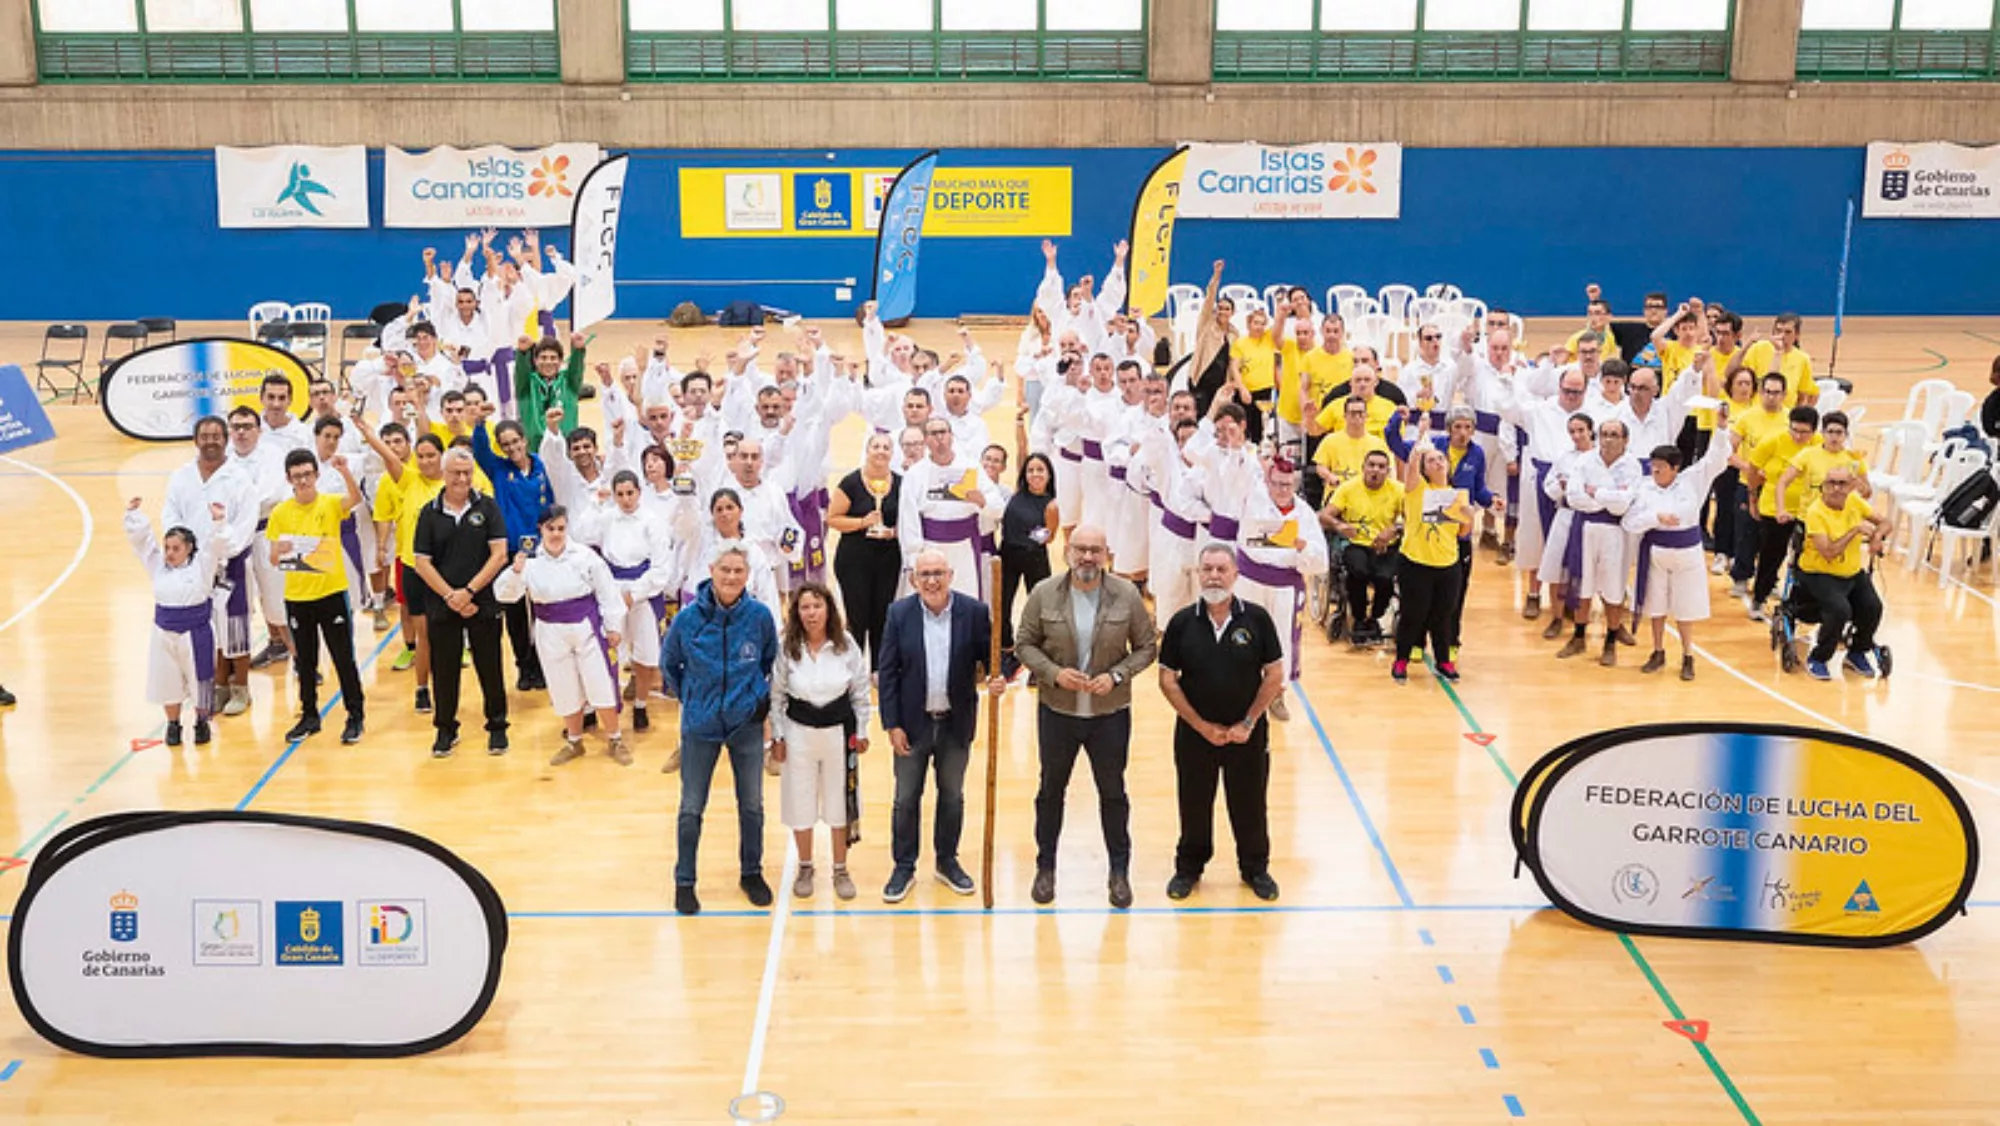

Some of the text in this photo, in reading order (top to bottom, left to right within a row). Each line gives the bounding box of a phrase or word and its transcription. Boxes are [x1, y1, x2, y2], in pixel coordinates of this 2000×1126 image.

[467, 155, 525, 178] Islas
[1260, 148, 1325, 171] Islas
[1197, 169, 1324, 194] Canarias
[1914, 170, 1977, 183] Gobierno
[932, 191, 1030, 210] DEPORTE
[1912, 184, 1991, 197] de Canarias
[1585, 785, 1921, 822] FEDERACIÓN DE LUCHA DEL
[1632, 823, 1868, 855] GARROTE CANARIO
[82, 950, 151, 962] Gobierno
[82, 964, 165, 976] de Canarias
